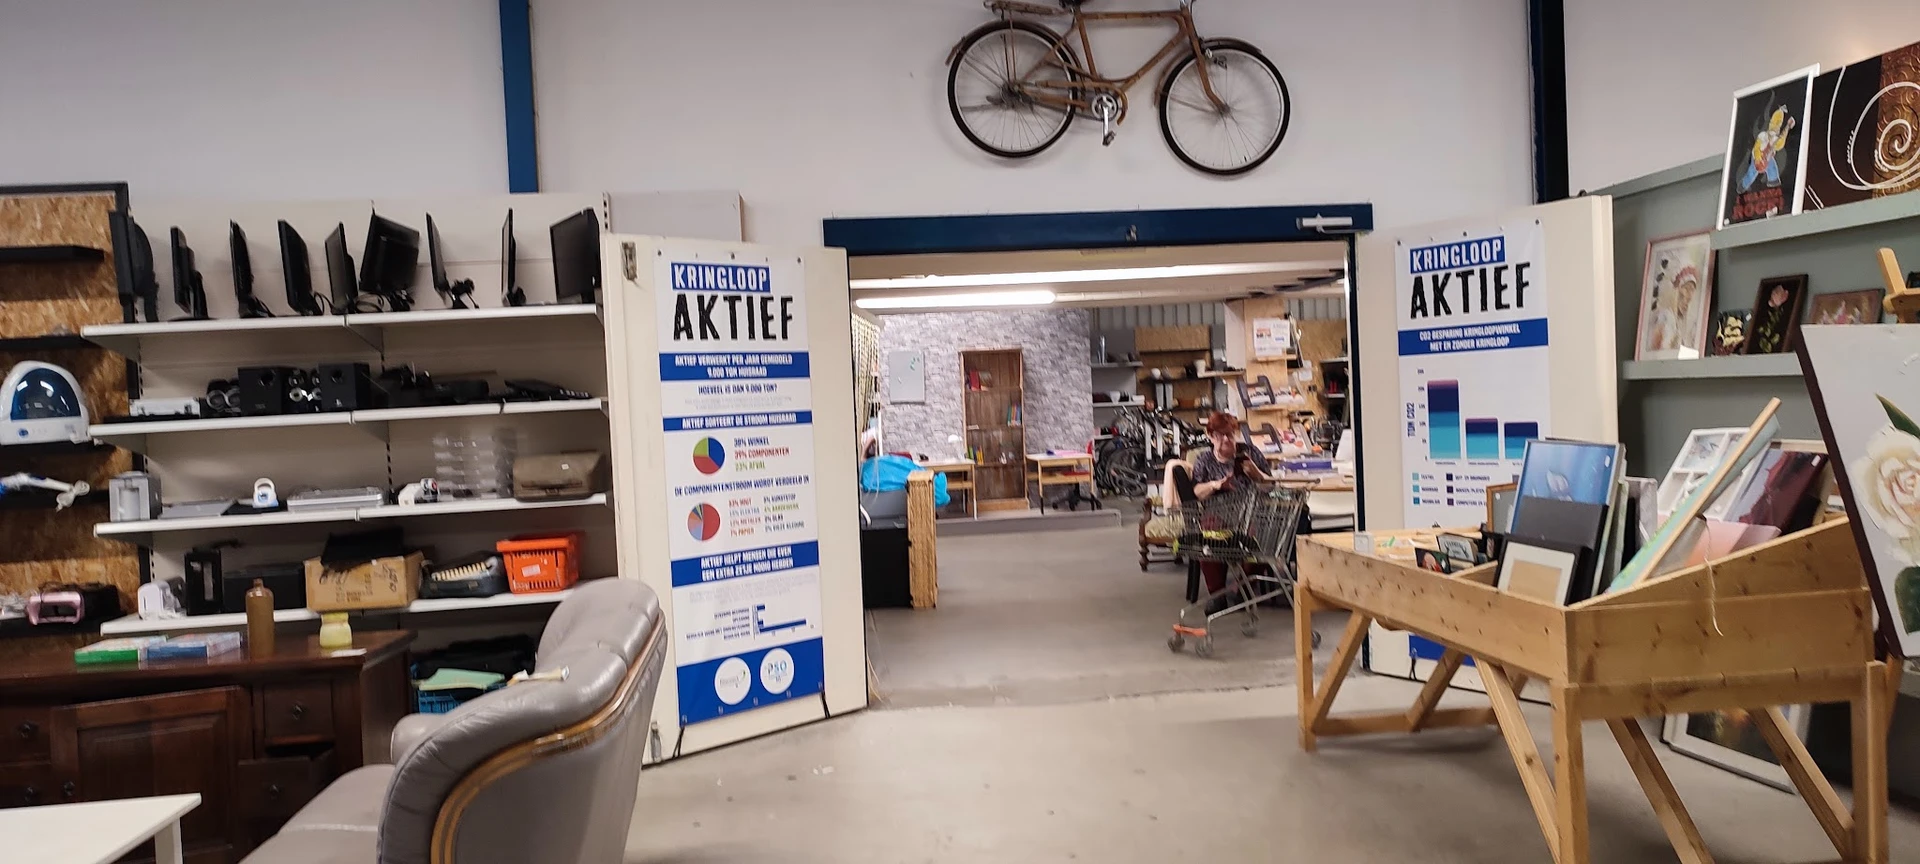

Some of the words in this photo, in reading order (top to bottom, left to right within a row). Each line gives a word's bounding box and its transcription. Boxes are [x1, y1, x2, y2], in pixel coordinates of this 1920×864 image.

[1413, 239, 1502, 272] KRINGLOOP
[674, 264, 767, 291] KRINGLOOP
[1410, 262, 1531, 319] AKTIEF
[673, 293, 793, 340] AKTIEF
[1419, 331, 1431, 341] CO2
[1432, 327, 1463, 340] BESPARING
[1464, 323, 1521, 336] KRINGLOOPWINKEL
[1429, 342, 1443, 352] MET
[1443, 340, 1451, 350] EN
[1452, 338, 1475, 350] ZONDER
[1476, 336, 1510, 347] KRINGLOOP
[675, 355, 697, 367] AKTIEF
[698, 354, 731, 366] VERWERKT
[732, 354, 744, 365] PER
[745, 354, 760, 365] JAAR
[761, 354, 793, 364] GEMIDDELD
[707, 367, 724, 378] 9.000
[725, 367, 738, 378] TON
[739, 366, 767, 377] HUISRAAD
[698, 384, 723, 395] HOEVEEL
[724, 385, 731, 393] IS
[732, 384, 745, 393] DAN
[763, 383, 778, 392] TON?
[682, 417, 704, 429] AKTIEF
[705, 416, 735, 428] SORTEERT
[735, 415, 743, 426] DE
[744, 414, 768, 426] STROOM
[769, 413, 797, 424] HUISRAAD
[748, 436, 770, 446] WINKEL
[748, 446, 790, 457] COMPONENTEN
[749, 460, 766, 471] AFVAL
[674, 487, 683, 497] DE
[684, 481, 753, 496] COMPONENTENSTROOM
[754, 479, 774, 490] WORDT
[775, 476, 803, 487] VERDEELD
[803, 475, 810, 484] IN
[701, 555, 723, 569] AKTIEF
[724, 552, 741, 566] HELPT
[742, 548, 767, 563] MENSEN
[766, 547, 777, 559] DIE
[777, 545, 792, 557] EVEN
[702, 568, 715, 582] EEN
[715, 565, 734, 580] EXTRA
[735, 563, 753, 577] ZETJE
[753, 560, 771, 574] NODIG
[771, 557, 794, 571] HEBBEN
[767, 660, 787, 675] PSO
